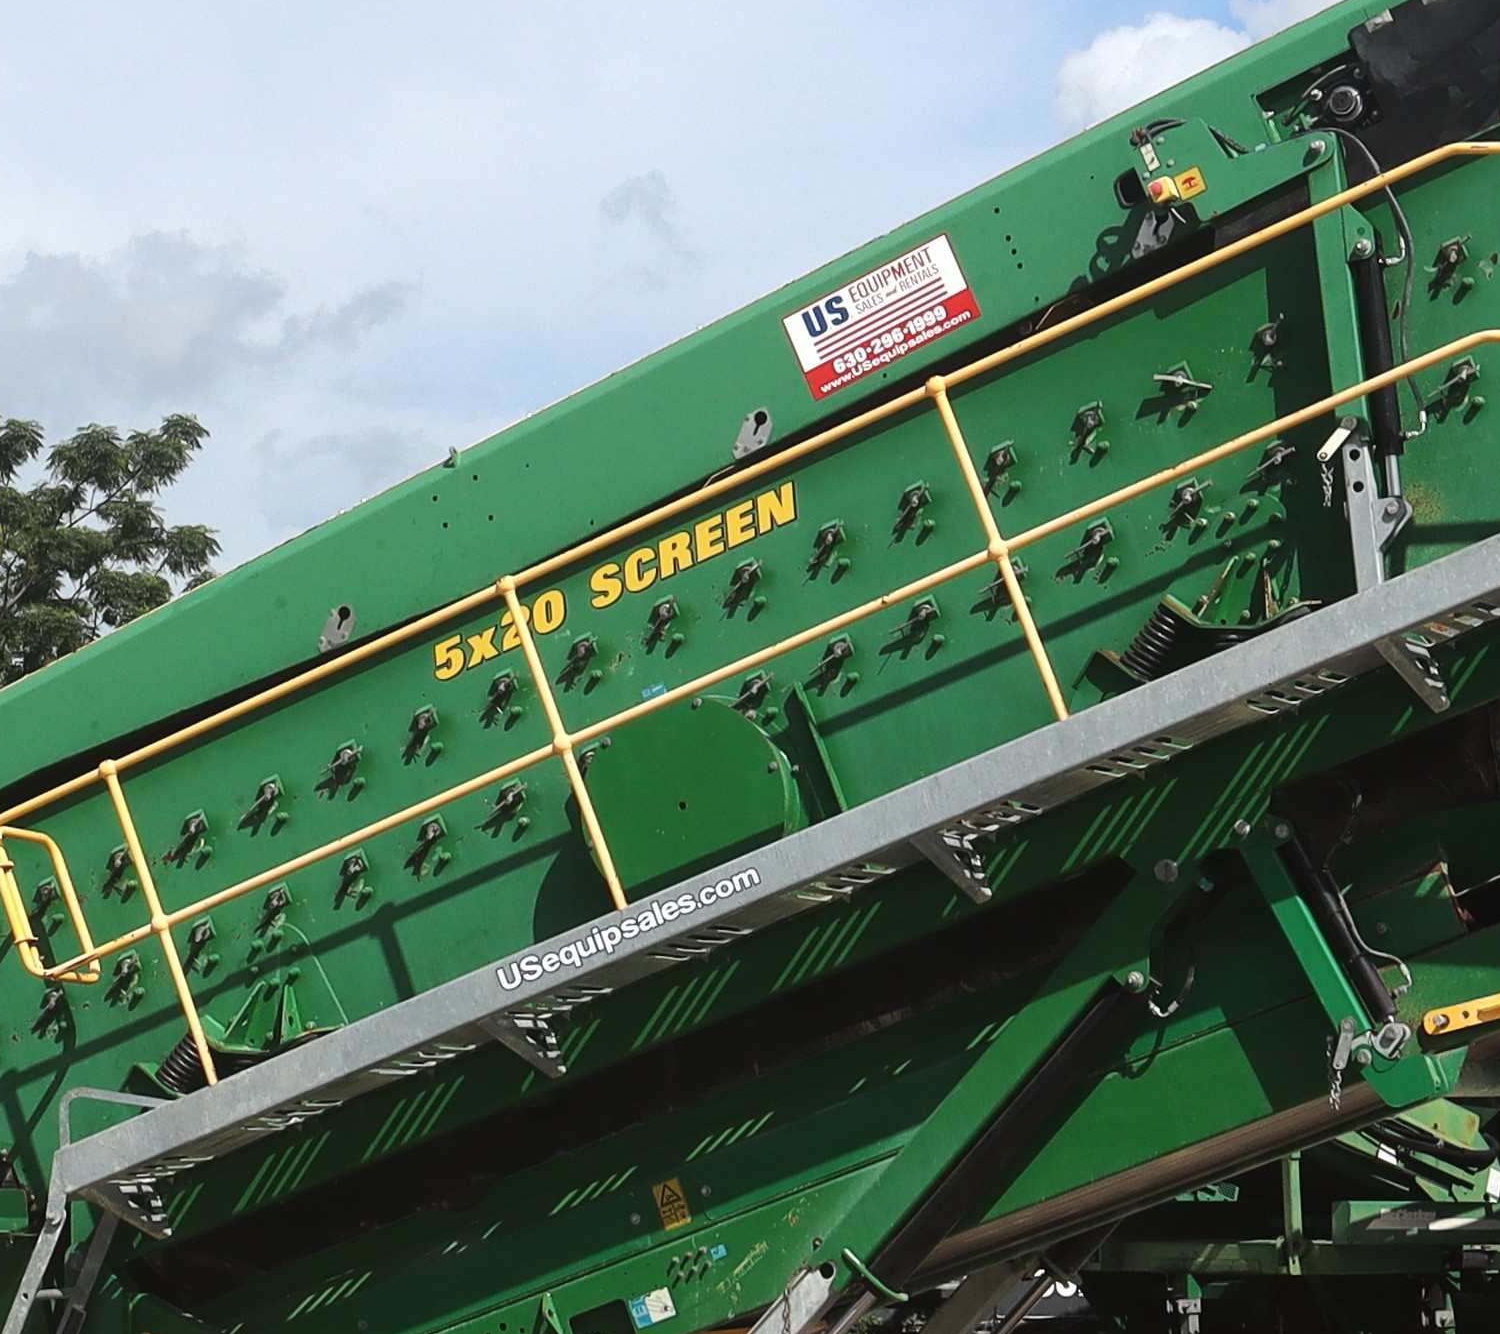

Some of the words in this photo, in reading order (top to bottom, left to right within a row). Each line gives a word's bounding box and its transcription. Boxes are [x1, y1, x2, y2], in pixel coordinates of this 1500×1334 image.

[801, 295, 850, 338] US
[848, 246, 934, 303] EQUIPMENT
[855, 292, 885, 315] SALES
[899, 263, 940, 292] RENTALS
[819, 310, 972, 394] www.USequipsales.com
[589, 481, 798, 609] SCREEN
[496, 867, 762, 991] USequipsales.com
